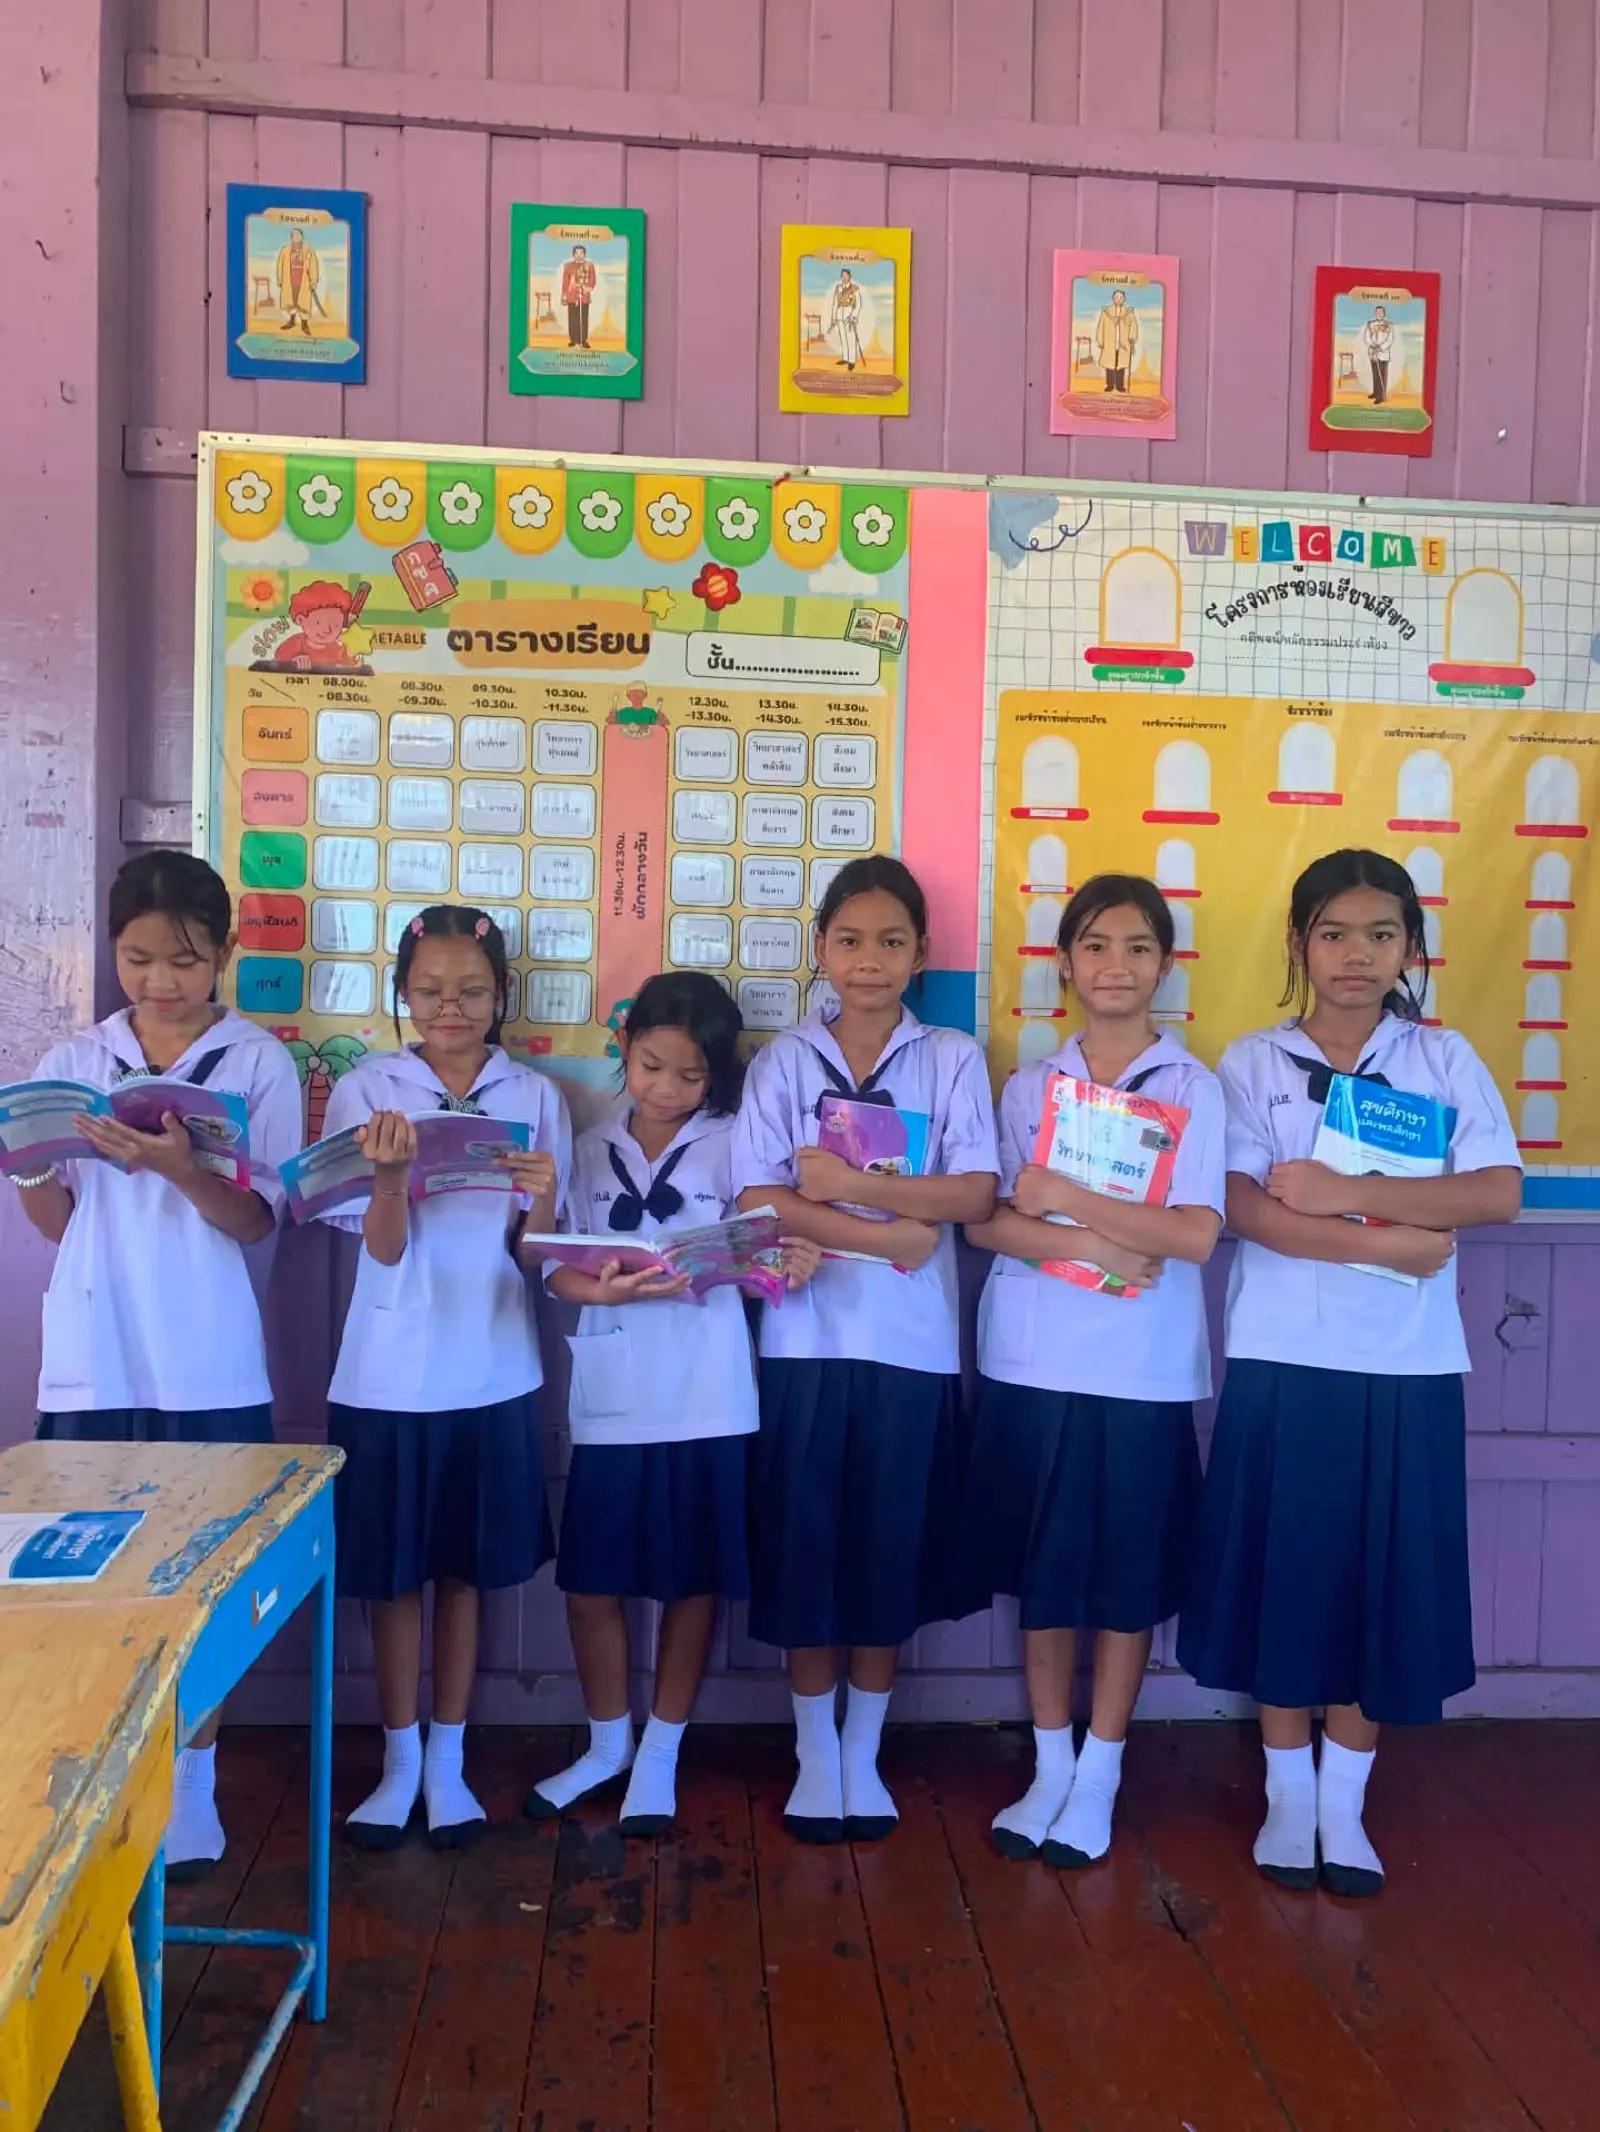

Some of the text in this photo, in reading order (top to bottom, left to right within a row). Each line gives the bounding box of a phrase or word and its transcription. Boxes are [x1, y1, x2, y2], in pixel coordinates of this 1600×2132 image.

[1192, 524, 1440, 567] WELCOME
[1204, 565, 1417, 641] โครงการห้องเรียนสีขาว
[446, 622, 650, 655] ตารางเรียน
[258, 727, 293, 739] จันทร์
[631, 832, 649, 920] พักกลางวัน
[1360, 1099, 1428, 1128] สุขศึกษา
